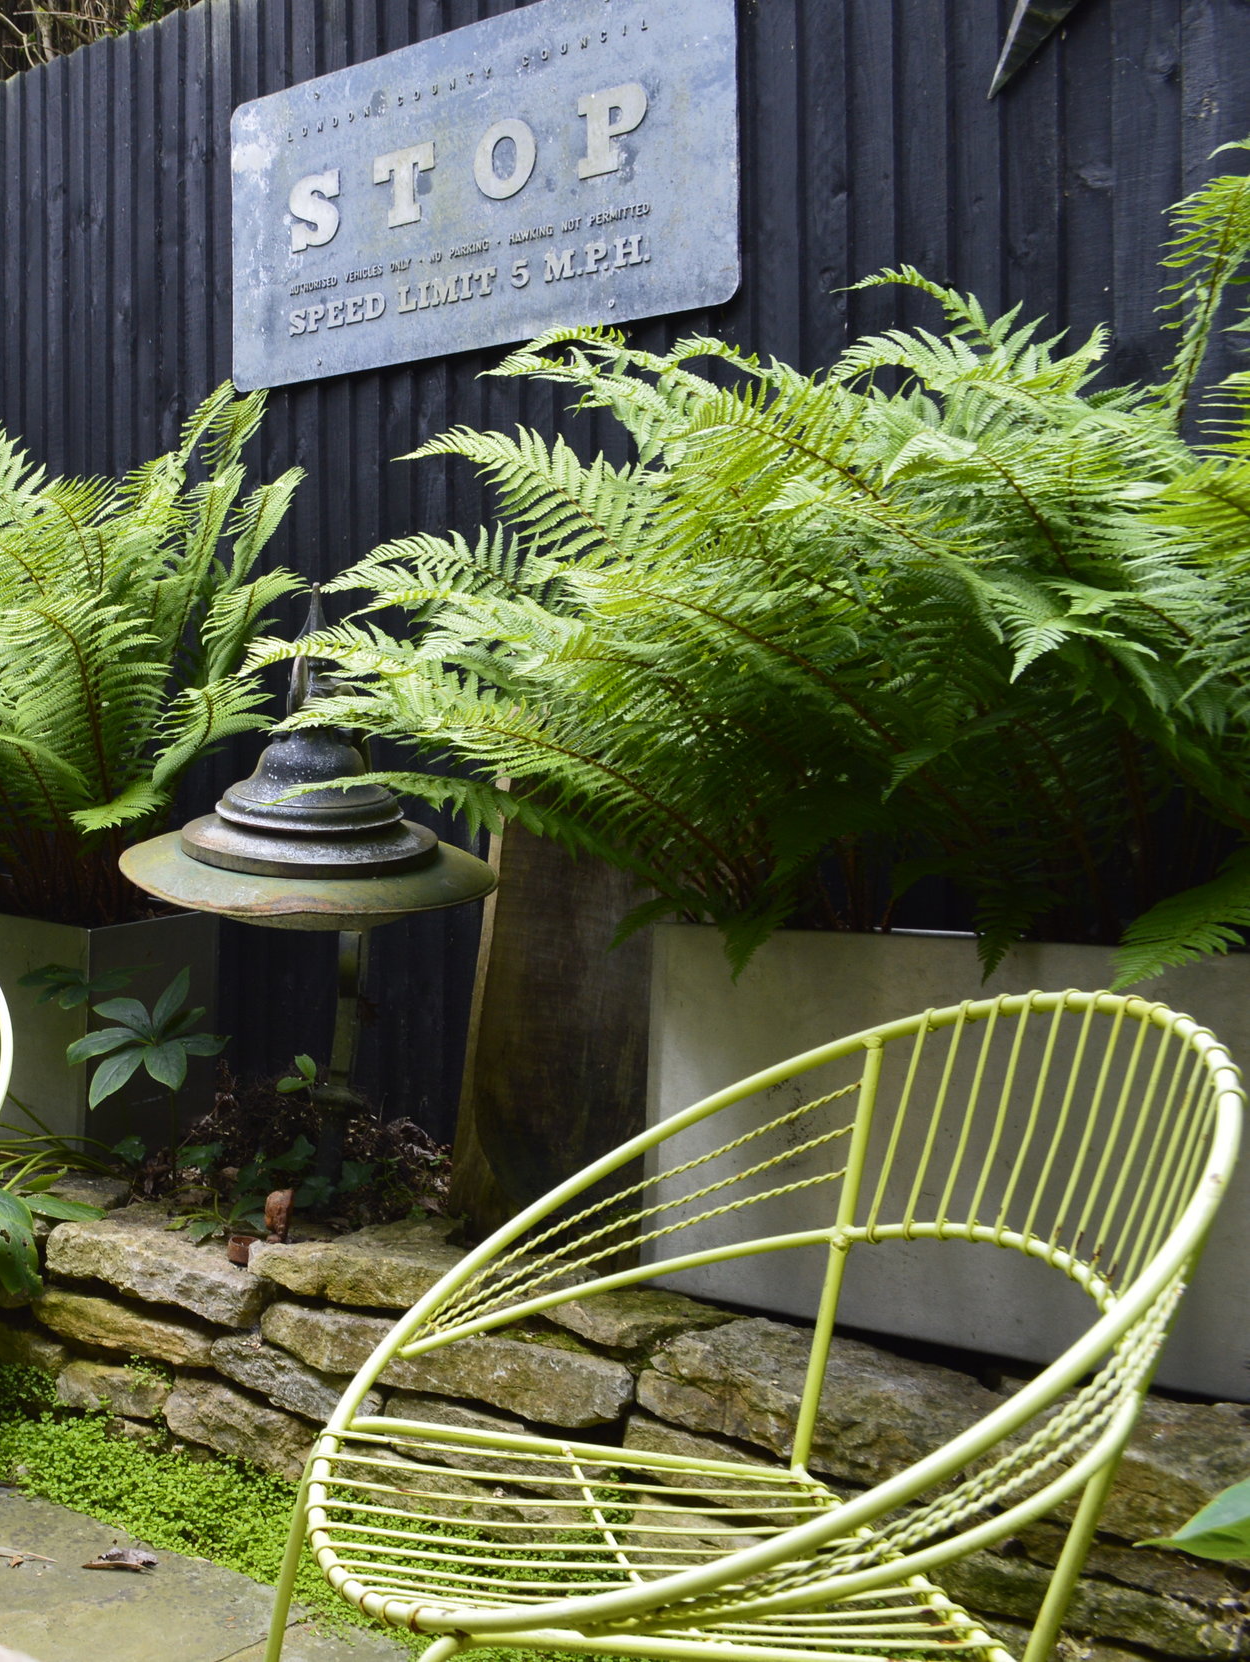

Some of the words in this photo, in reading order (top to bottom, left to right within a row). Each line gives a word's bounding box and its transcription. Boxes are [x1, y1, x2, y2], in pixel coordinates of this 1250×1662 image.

[287, 105, 372, 142] LONDON
[397, 67, 492, 105] COUNTY
[522, 19, 649, 67] COUNCIL
[289, 83, 649, 254] STOP
[289, 292, 387, 337] SPEED
[397, 267, 498, 314] LIMIT
[510, 260, 531, 290] 5
[543, 234, 652, 283] M.P.H.
[290, 276, 337, 296] AUTHORISED
[344, 264, 383, 284] VEHICLES
[389, 258, 413, 273] ONLY
[429, 250, 443, 264] NO
[449, 239, 490, 259] PARKING
[508, 224, 554, 244] HAWKING
[561, 217, 582, 232] NOT
[588, 202, 651, 228] PERMITTED
